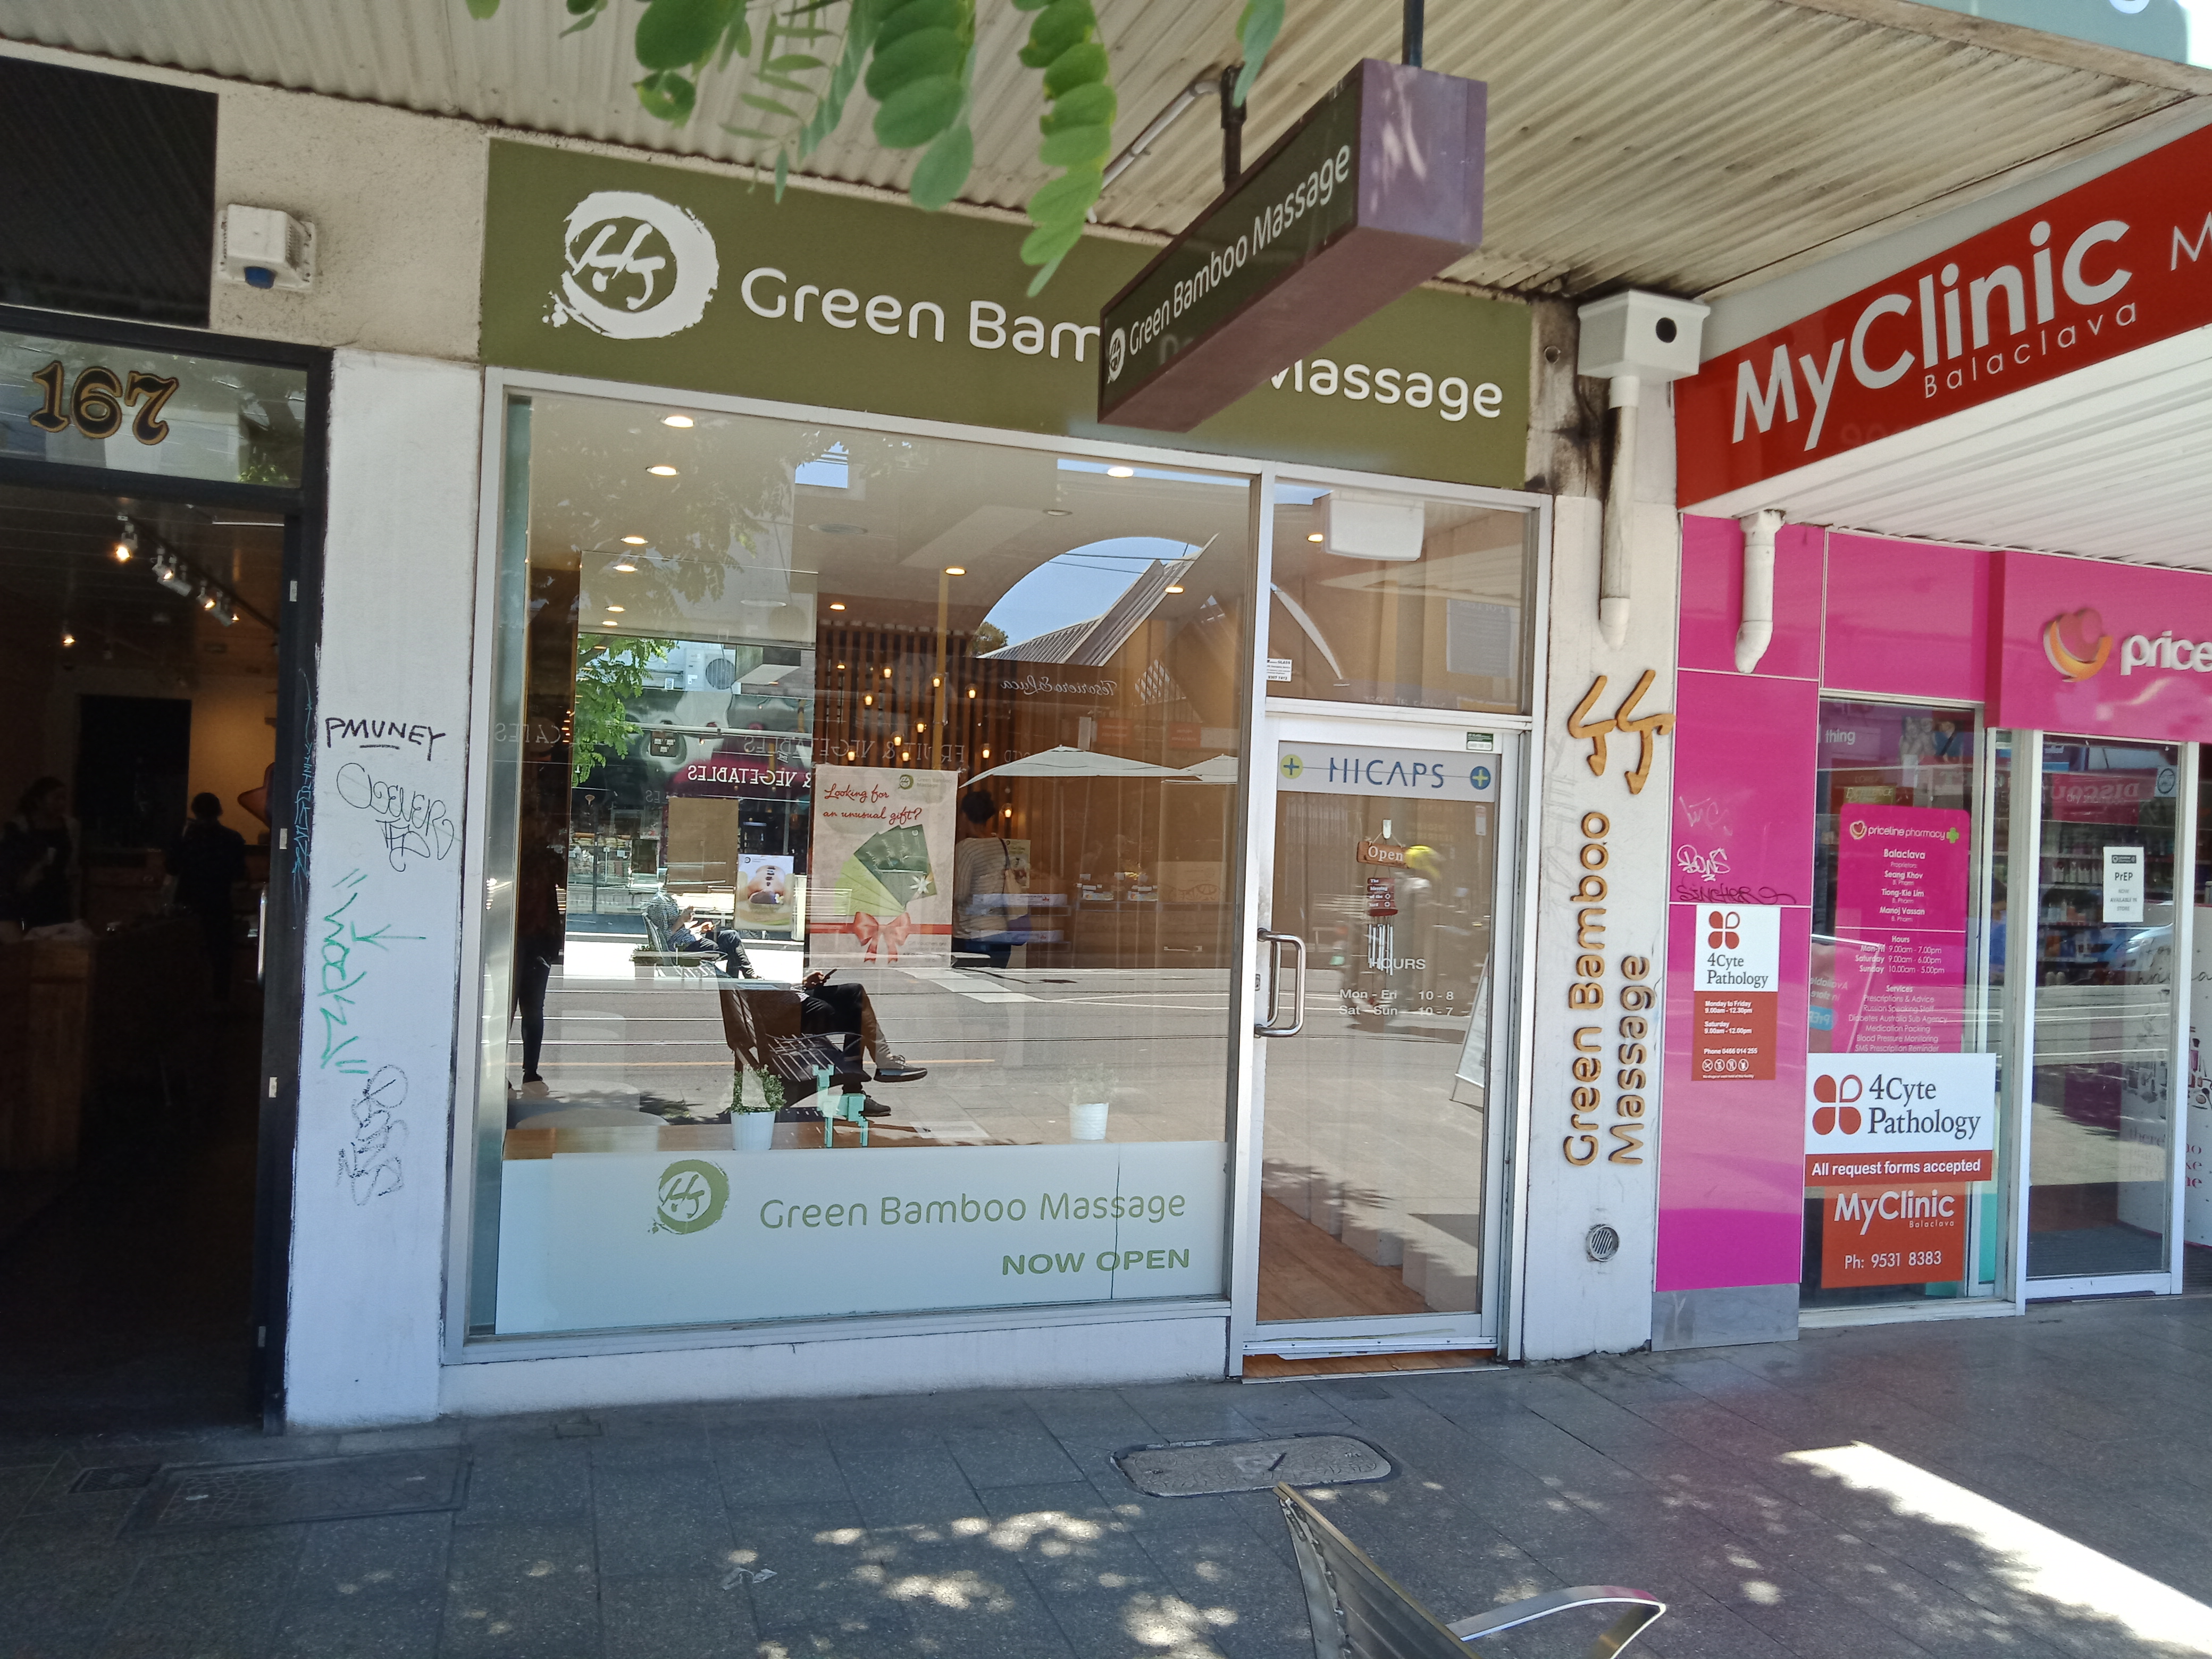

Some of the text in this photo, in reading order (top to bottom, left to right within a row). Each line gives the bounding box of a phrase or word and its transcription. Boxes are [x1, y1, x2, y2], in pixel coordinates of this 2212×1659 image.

[1130, 145, 1351, 357] Green Bamboo Massage
[741, 267, 946, 343] Green
[969, 300, 1100, 363] Bam
[1732, 221, 2133, 452] MyClinic
[1924, 302, 2138, 399] Balaclava
[29, 359, 180, 446] 167
[1825, 728, 1856, 745] thing
[1329, 757, 1444, 789] HICAPS
[824, 783, 890, 803] Looking for
[841, 807, 886, 819] unusual
[889, 806, 923, 825] gift?
[1867, 825, 1946, 842] priceline pharmacy
[1368, 845, 1403, 861] Open
[1883, 848, 1925, 860] Balaclava
[1884, 870, 1906, 880] Seang
[2115, 872, 2133, 881] PrEP
[1879, 906, 1900, 916] Manoj
[1888, 945, 1913, 953] 9.00am
[1917, 945, 1942, 955] 7.00pm
[1369, 958, 1426, 970] HOURS
[1707, 952, 1744, 970] 4Cyte
[1855, 954, 1942, 965] Saturday 9.00am 6.00pm
[1859, 965, 1885, 974] Sunday
[1706, 969, 1769, 989] Pathology
[1339, 989, 1454, 1001] Mon Fri 10 8
[1562, 810, 1611, 1167] Green Bamboo
[1886, 984, 1913, 993] Services
[1704, 1000, 1727, 1008] Monday
[1863, 994, 1904, 1003] Prescriptions
[1338, 1005, 1361, 1016] Sat
[1373, 1006, 1398, 1016] Sun
[1446, 1007, 1454, 1017] 7
[1904, 1025, 1931, 1034] Packing
[1904, 1035, 1939, 1044] Monitoring
[1608, 953, 1656, 1167] Massage
[1869, 1074, 1937, 1107] 4Cyte
[1867, 1107, 1981, 1140] Pathology
[1812, 1159, 1981, 1178] All request forms accepted
[760, 1192, 1186, 1229] Green Bamboo Massage
[1834, 1189, 1955, 1235] MyClinic
[1909, 1220, 1954, 1228] Balaclava
[1002, 1249, 1190, 1276] NOW OPEN
[1844, 1251, 1942, 1269] Ph: 9531 8383
